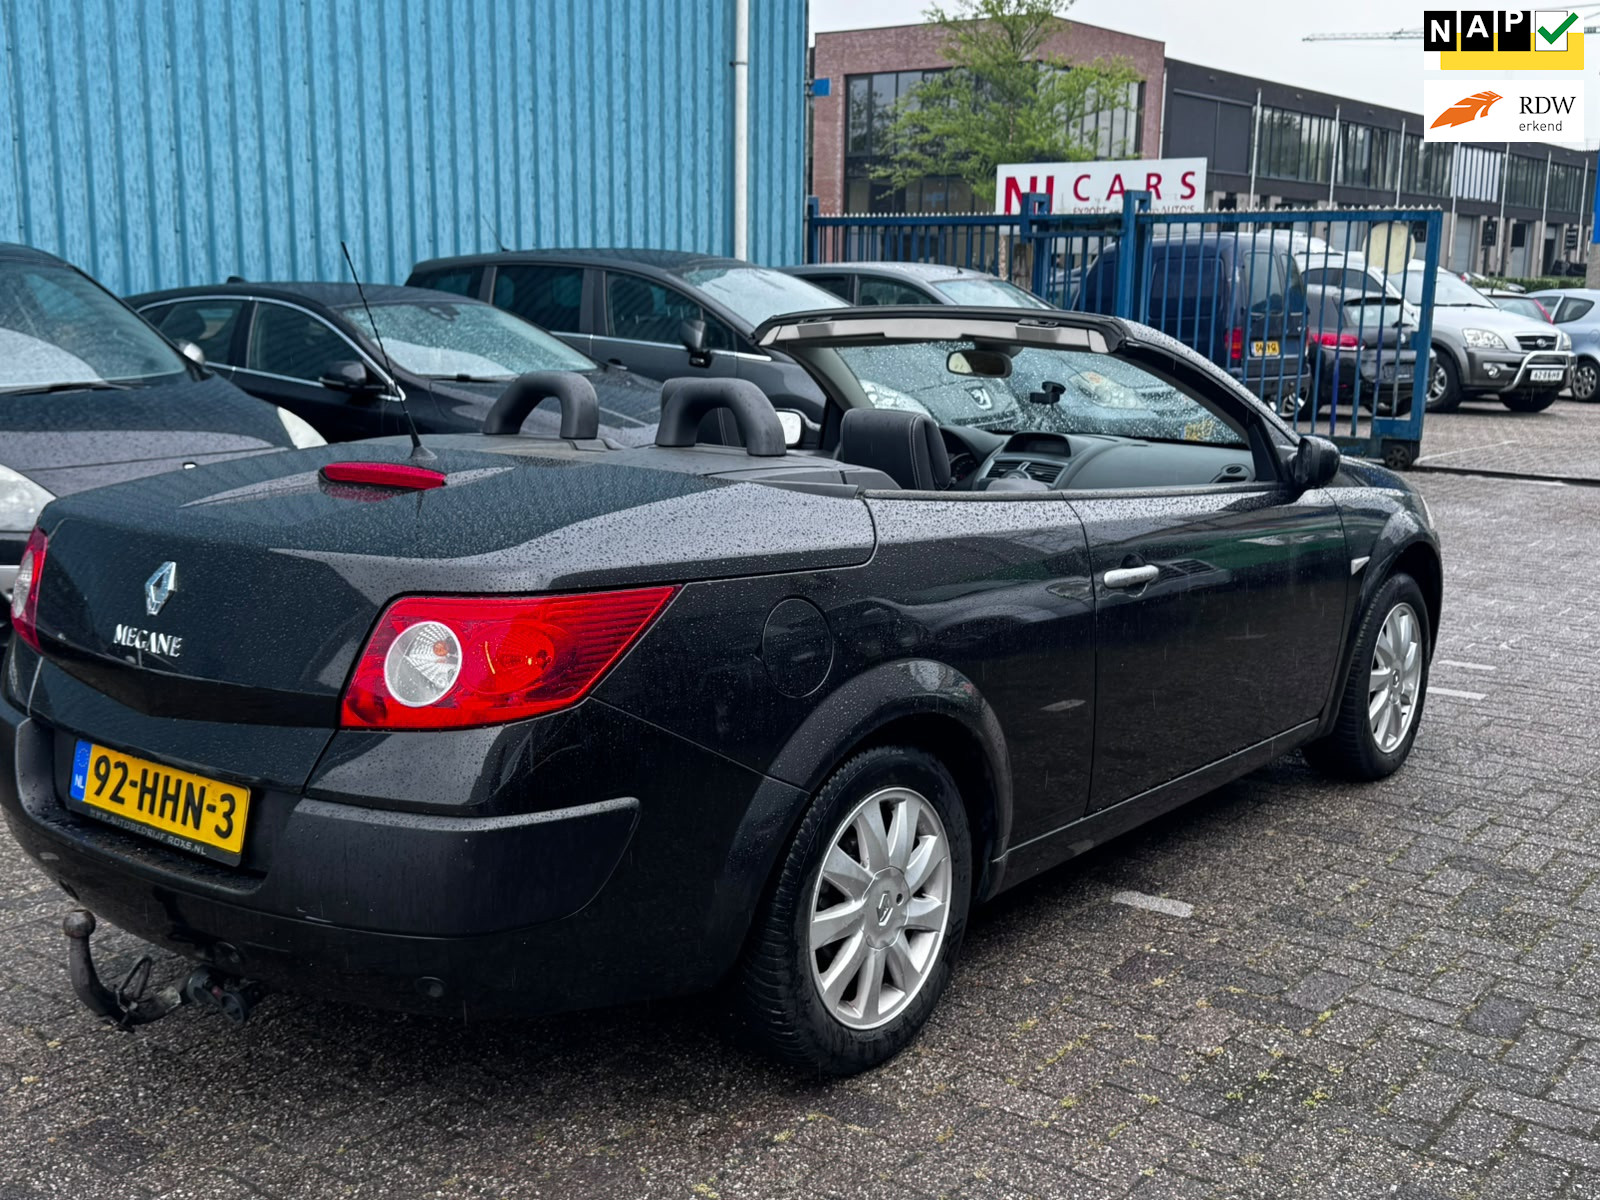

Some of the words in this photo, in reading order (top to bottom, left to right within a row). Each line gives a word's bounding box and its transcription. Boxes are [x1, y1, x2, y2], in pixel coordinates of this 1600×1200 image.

[1072, 171, 1196, 202] CARS
[113, 623, 183, 658] MEGANE
[74, 773, 85, 790] NL
[93, 754, 236, 840] 92-HHN-3
